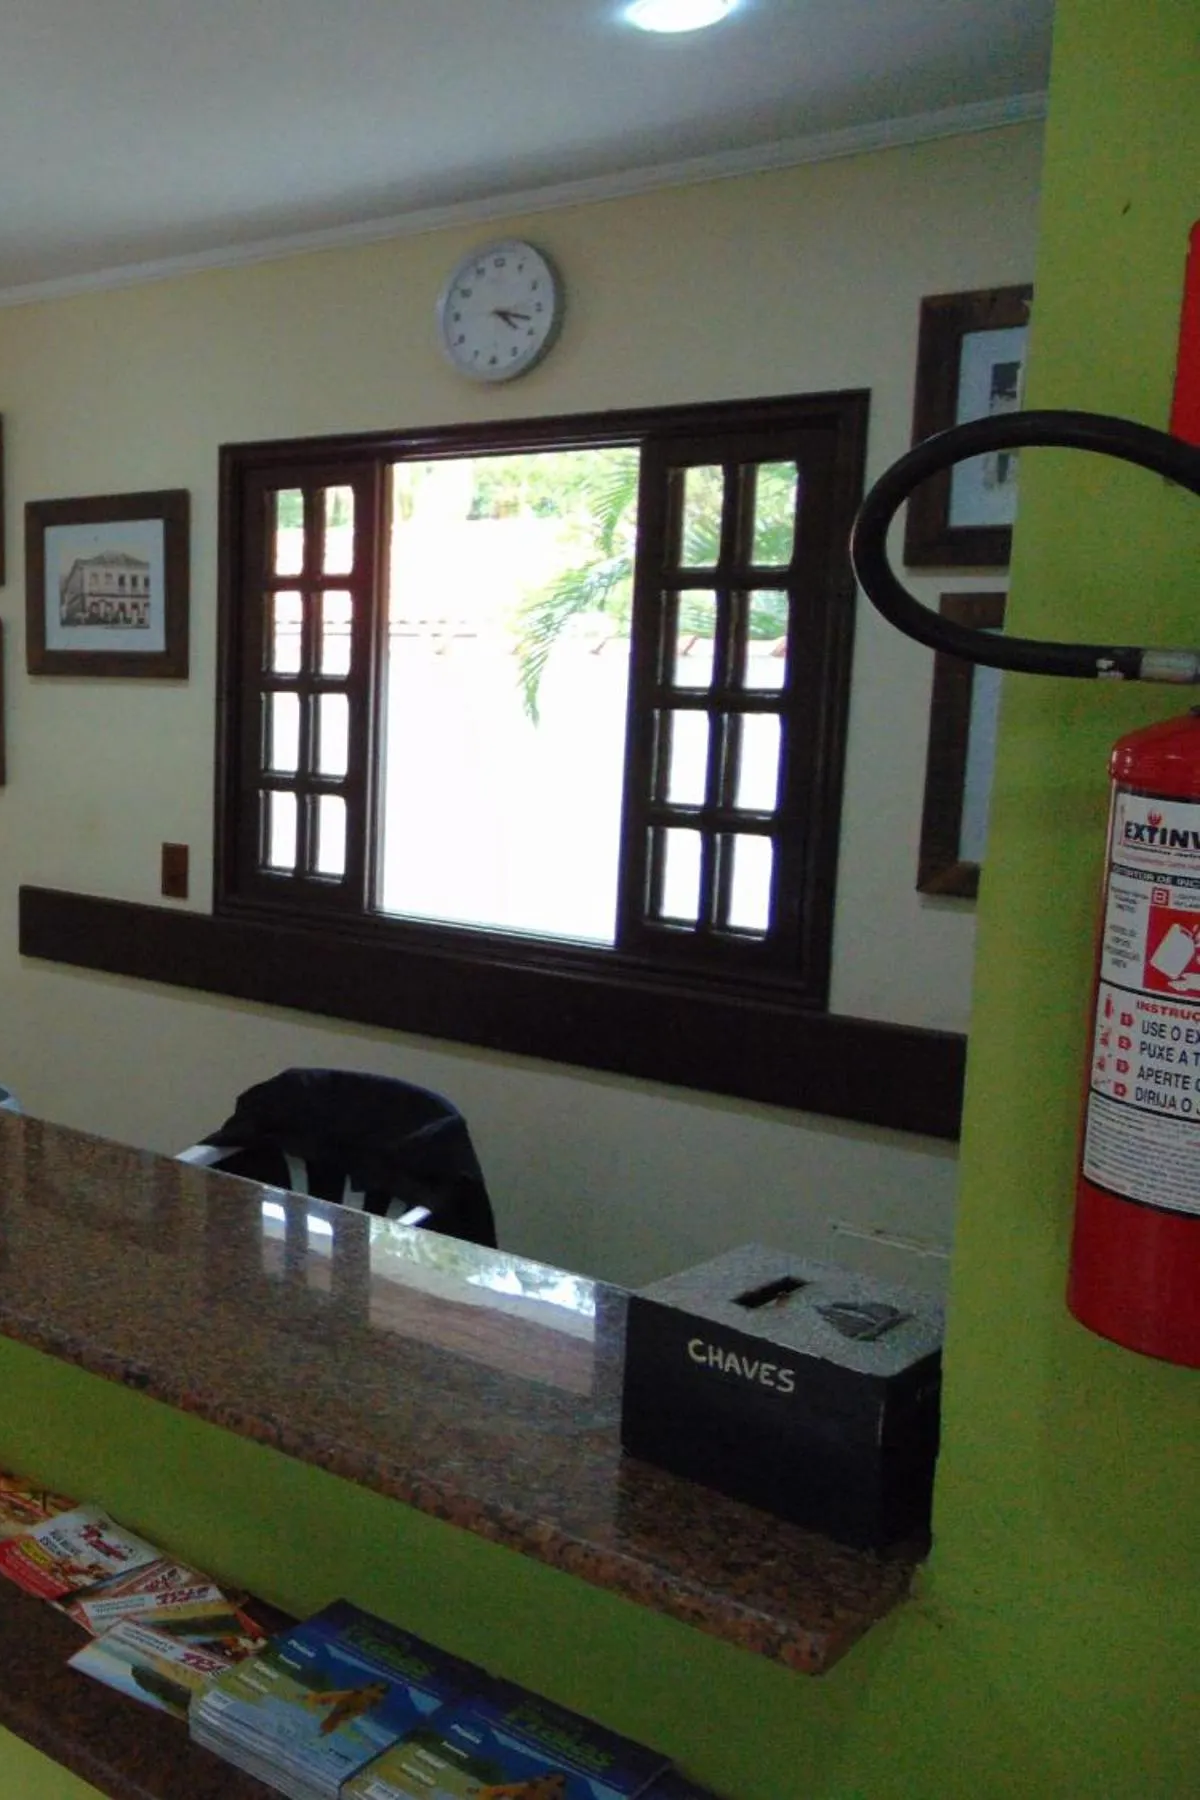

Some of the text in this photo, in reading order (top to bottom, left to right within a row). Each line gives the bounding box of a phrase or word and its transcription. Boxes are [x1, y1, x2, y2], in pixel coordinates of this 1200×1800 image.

[1141, 1020, 1167, 1039] USE
[1171, 1025, 1181, 1042] O
[1140, 1041, 1175, 1063] PUXE
[1178, 1050, 1188, 1067] A
[1137, 1065, 1191, 1091] APERTE
[1135, 1086, 1177, 1109] DIRIJA
[1181, 1097, 1192, 1113] O
[687, 1338, 796, 1393] CHAVES
